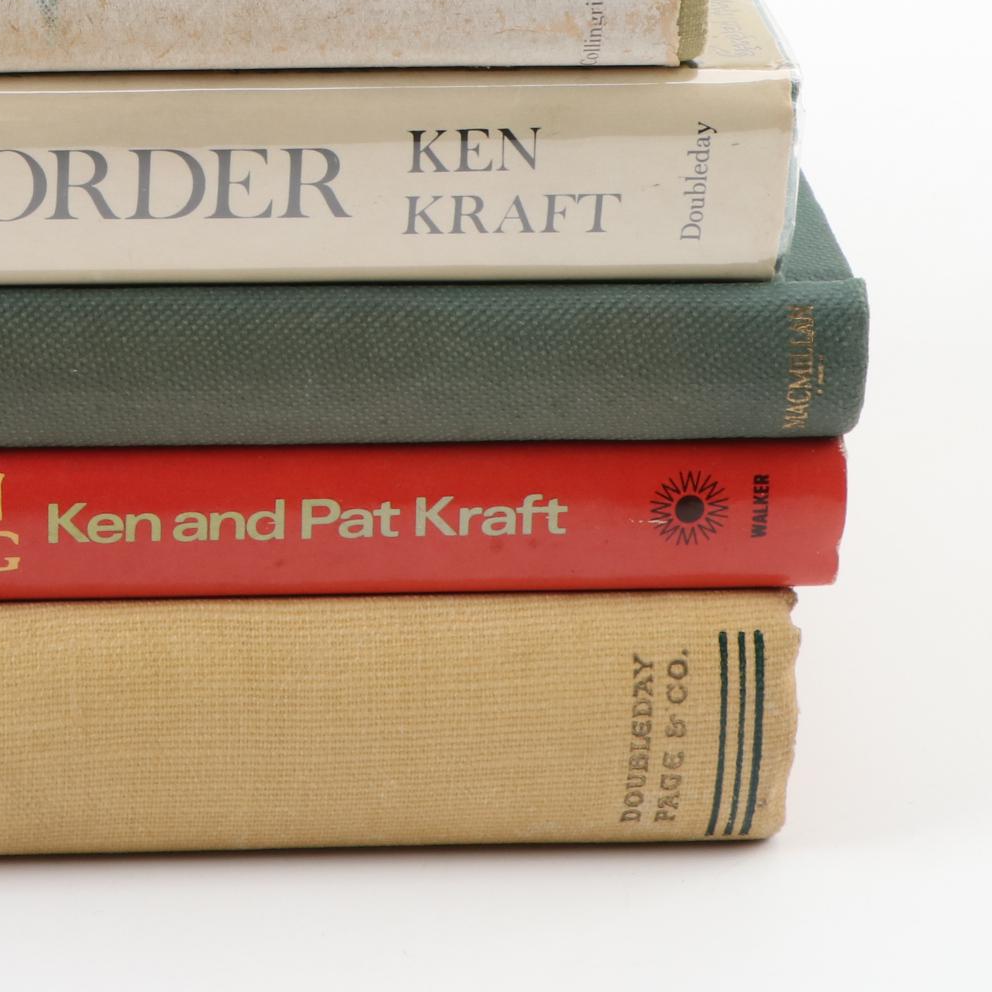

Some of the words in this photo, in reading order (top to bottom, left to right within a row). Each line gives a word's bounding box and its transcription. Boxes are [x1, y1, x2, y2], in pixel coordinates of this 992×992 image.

[407, 127, 542, 173] KEN
[680, 121, 717, 241] Doubleday
[402, 193, 622, 235] KRAFT
[782, 305, 816, 429] MACMILLAN
[48, 502, 162, 544] Ken
[173, 499, 285, 542] and
[301, 498, 401, 539] Pat
[415, 494, 568, 537] Kraft
[751, 474, 769, 538] WALKER
[666, 649, 690, 705] CO.
[619, 652, 654, 822] DOUBLEDAY
[665, 714, 687, 738] &
[654, 751, 684, 823] PAGE
